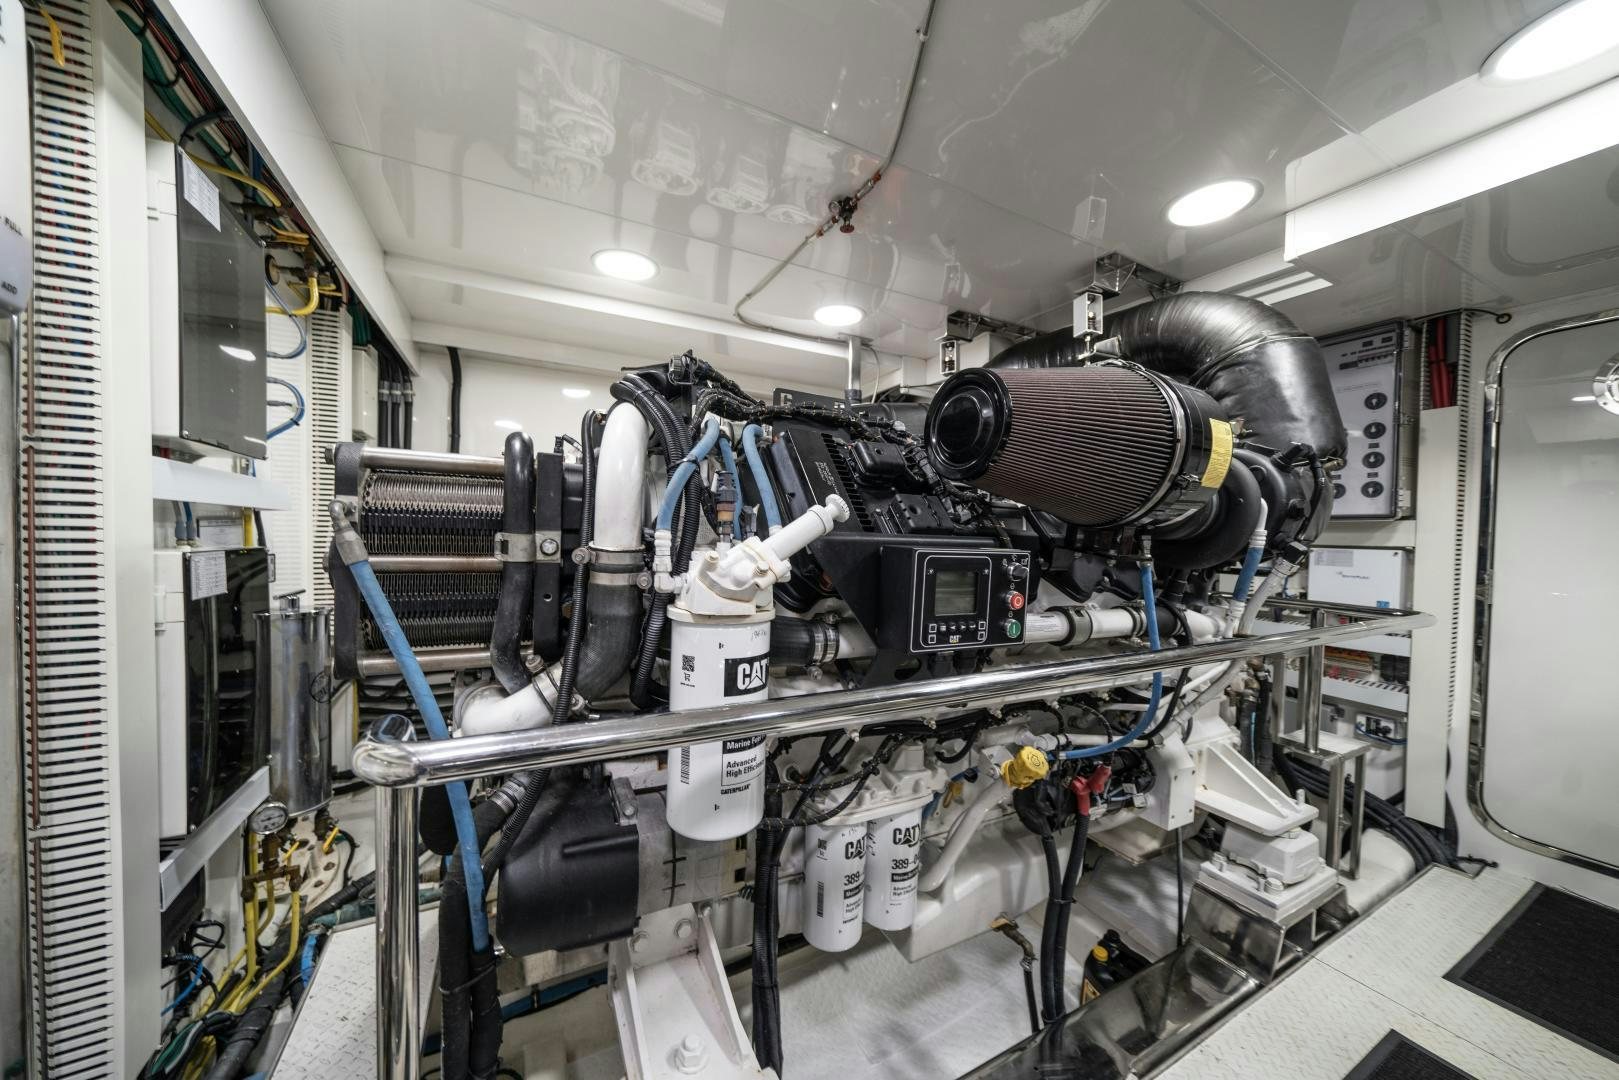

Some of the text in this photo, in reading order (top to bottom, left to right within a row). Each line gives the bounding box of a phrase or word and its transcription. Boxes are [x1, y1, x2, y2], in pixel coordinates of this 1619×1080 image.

[949, 635, 960, 644] CAT
[737, 658, 769, 690] CAT
[726, 740, 751, 750] Marine
[726, 755, 757, 769] Advanced
[726, 768, 742, 778] High
[721, 784, 750, 795] CATERPILLAR
[893, 825, 918, 846] CAT
[845, 835, 866, 860] CAT
